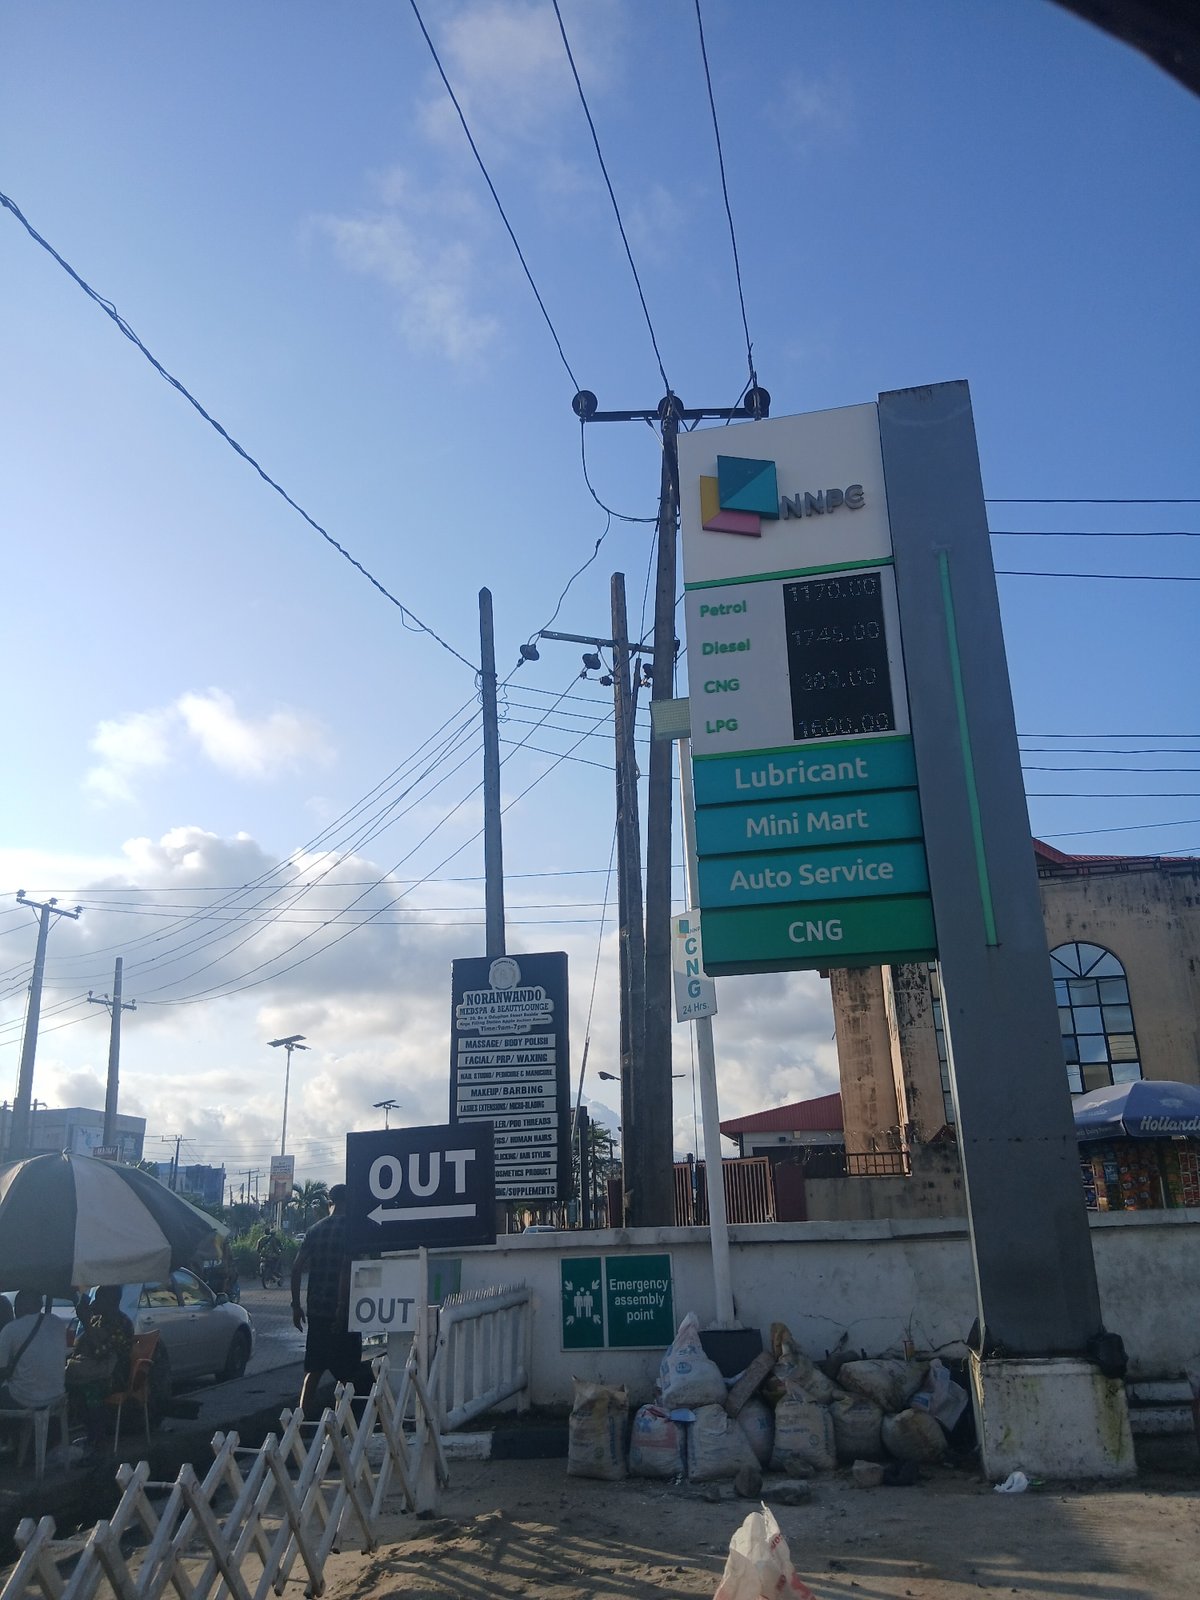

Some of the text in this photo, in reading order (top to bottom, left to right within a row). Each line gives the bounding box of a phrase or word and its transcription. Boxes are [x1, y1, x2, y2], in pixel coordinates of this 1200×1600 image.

[781, 484, 866, 521] NNPC
[700, 600, 747, 617] Petrol
[702, 639, 750, 655] Diesel
[704, 678, 740, 694] CNG
[706, 718, 738, 734] LPG
[735, 757, 869, 789] Lubricant
[746, 809, 869, 838] Mini Mart
[729, 858, 894, 891] Auto Service
[788, 919, 843, 943] CNG
[685, 938, 701, 998] CNG
[460, 1002, 549, 1016] MEDSPA & BEAUTYLOUNGE
[683, 1005, 692, 1015] 24
[504, 1039, 523, 1047] BODY
[524, 1037, 549, 1046] POLISH
[465, 1053, 548, 1065] FACIAL/ PRP/ WAXING
[494, 1117, 552, 1129] LER/PDO THREADS
[510, 1135, 533, 1143] HUMAN
[533, 1134, 553, 1142] HAIRS
[368, 1149, 476, 1200] OUT
[495, 1168, 552, 1177] OSMETICS PRODUCT
[609, 1279, 668, 1293] Emergency
[614, 1292, 665, 1308] assembly
[355, 1297, 415, 1324] OUT
[626, 1309, 654, 1324] point
